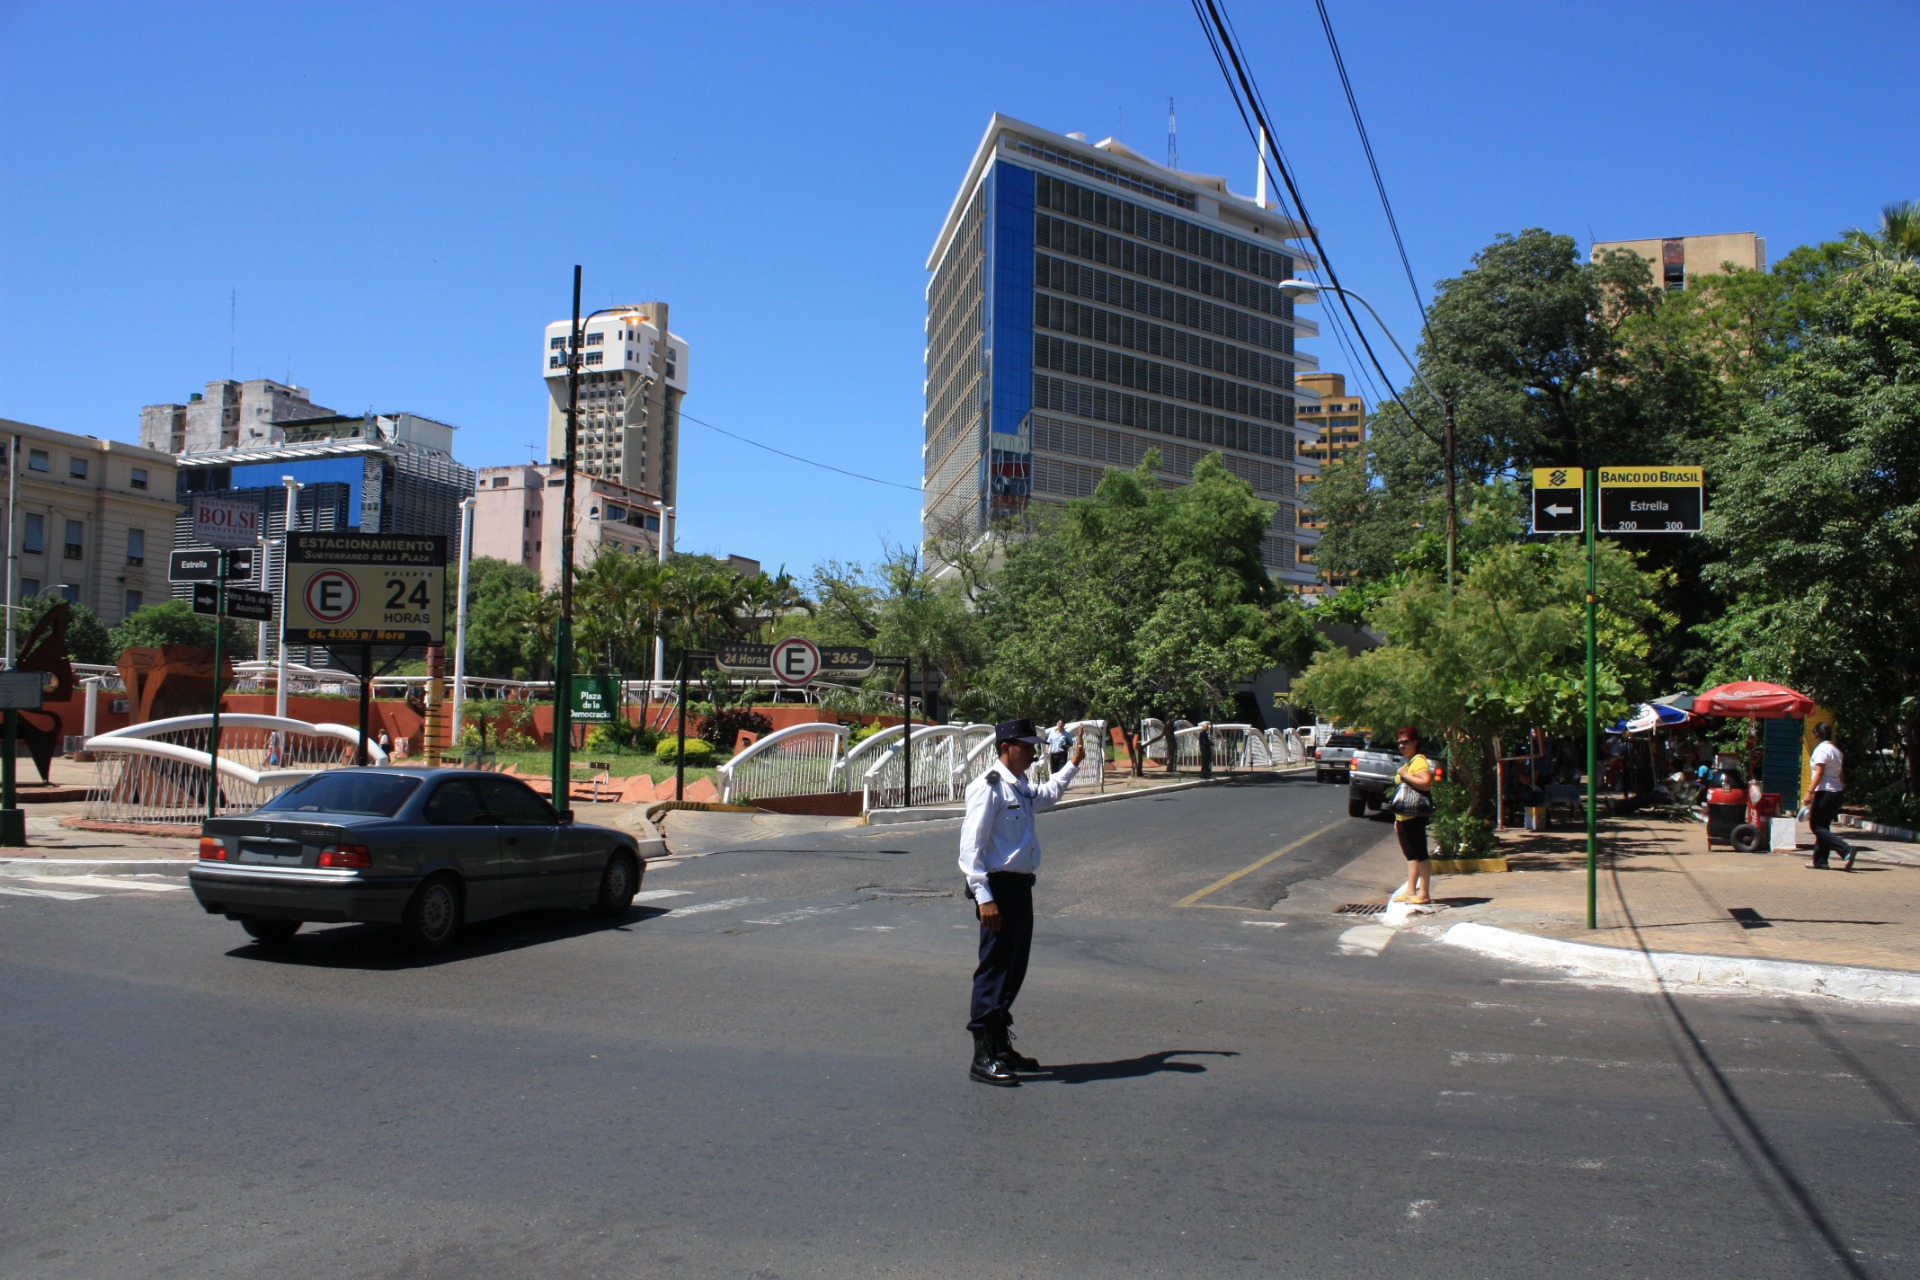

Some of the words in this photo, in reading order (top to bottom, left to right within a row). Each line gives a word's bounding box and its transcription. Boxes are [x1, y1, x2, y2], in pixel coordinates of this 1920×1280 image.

[1601, 471, 1640, 483] BANCO
[1642, 473, 1658, 483] DO
[1660, 471, 1700, 482] BRASIL
[1630, 500, 1669, 511] Estrella
[199, 506, 256, 529] BOLSI
[1619, 521, 1637, 530] 200
[1665, 521, 1683, 530] 300
[300, 537, 434, 551] ESTACIONAMIENTO
[304, 550, 369, 561] SUBTERRANEO
[401, 552, 430, 562] PLAZA
[181, 561, 207, 569] Estrella
[320, 580, 343, 612] E
[385, 579, 431, 610] 24
[384, 612, 431, 624] HORAS
[308, 629, 326, 640] Gs.
[328, 629, 358, 640] 4.000
[377, 630, 406, 640] Hora
[724, 653, 737, 664] 24
[738, 653, 769, 664] Horas
[786, 647, 806, 675] E
[831, 652, 858, 664] 365
[581, 691, 601, 700] Plaza
[582, 701, 591, 709] de
[593, 701, 600, 709] la
